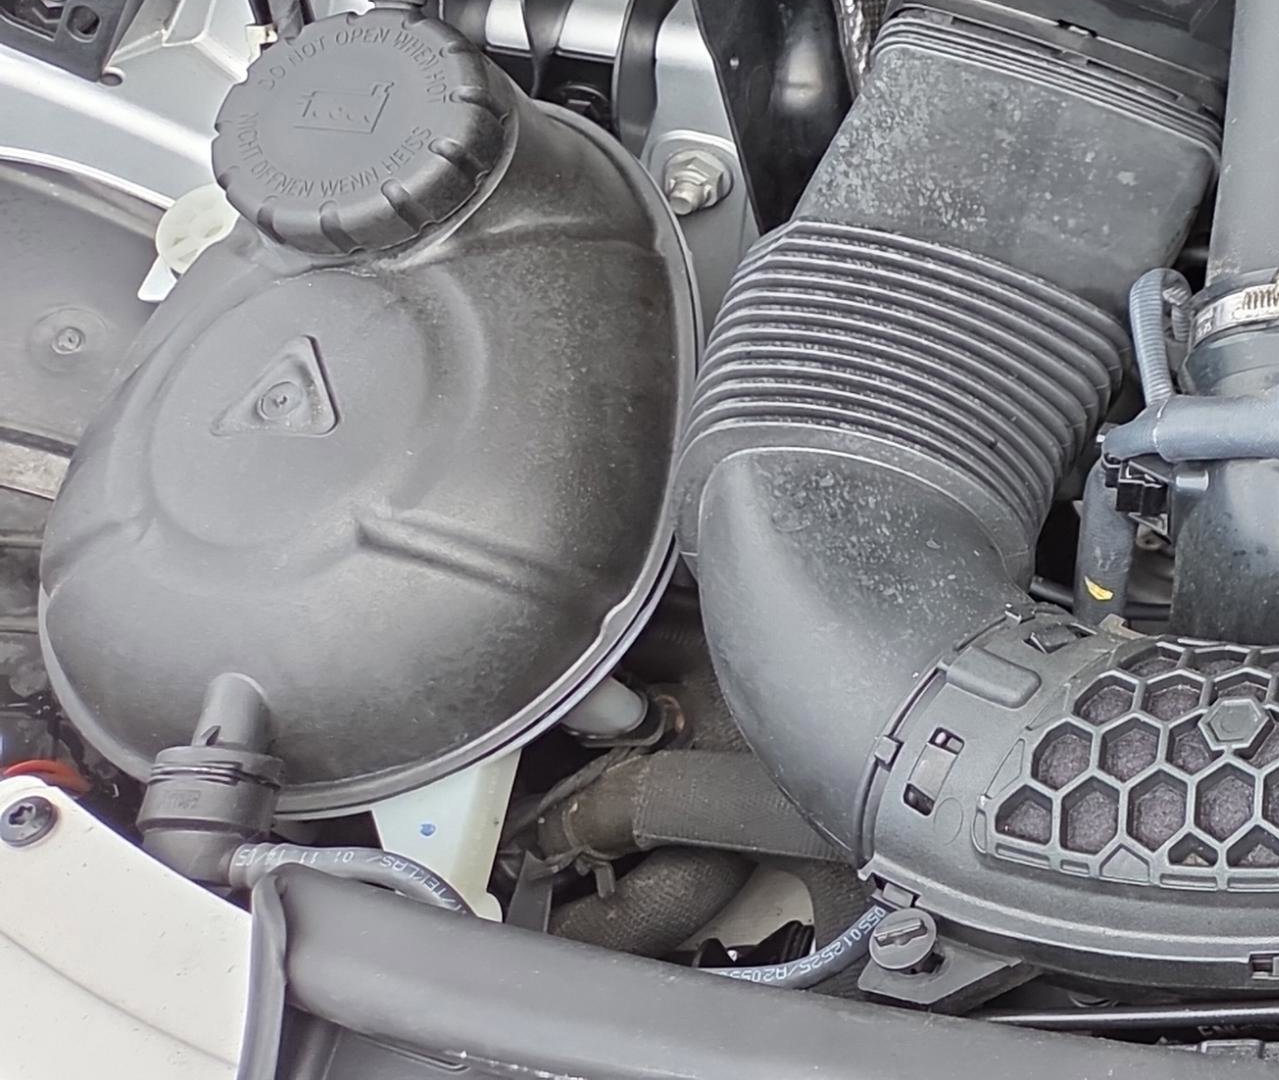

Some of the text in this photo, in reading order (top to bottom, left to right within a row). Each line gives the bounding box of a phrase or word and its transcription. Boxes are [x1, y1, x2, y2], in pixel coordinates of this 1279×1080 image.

[258, 28, 449, 104] DO NOT OPEN WHEN HOT
[320, 166, 380, 198] WENN
